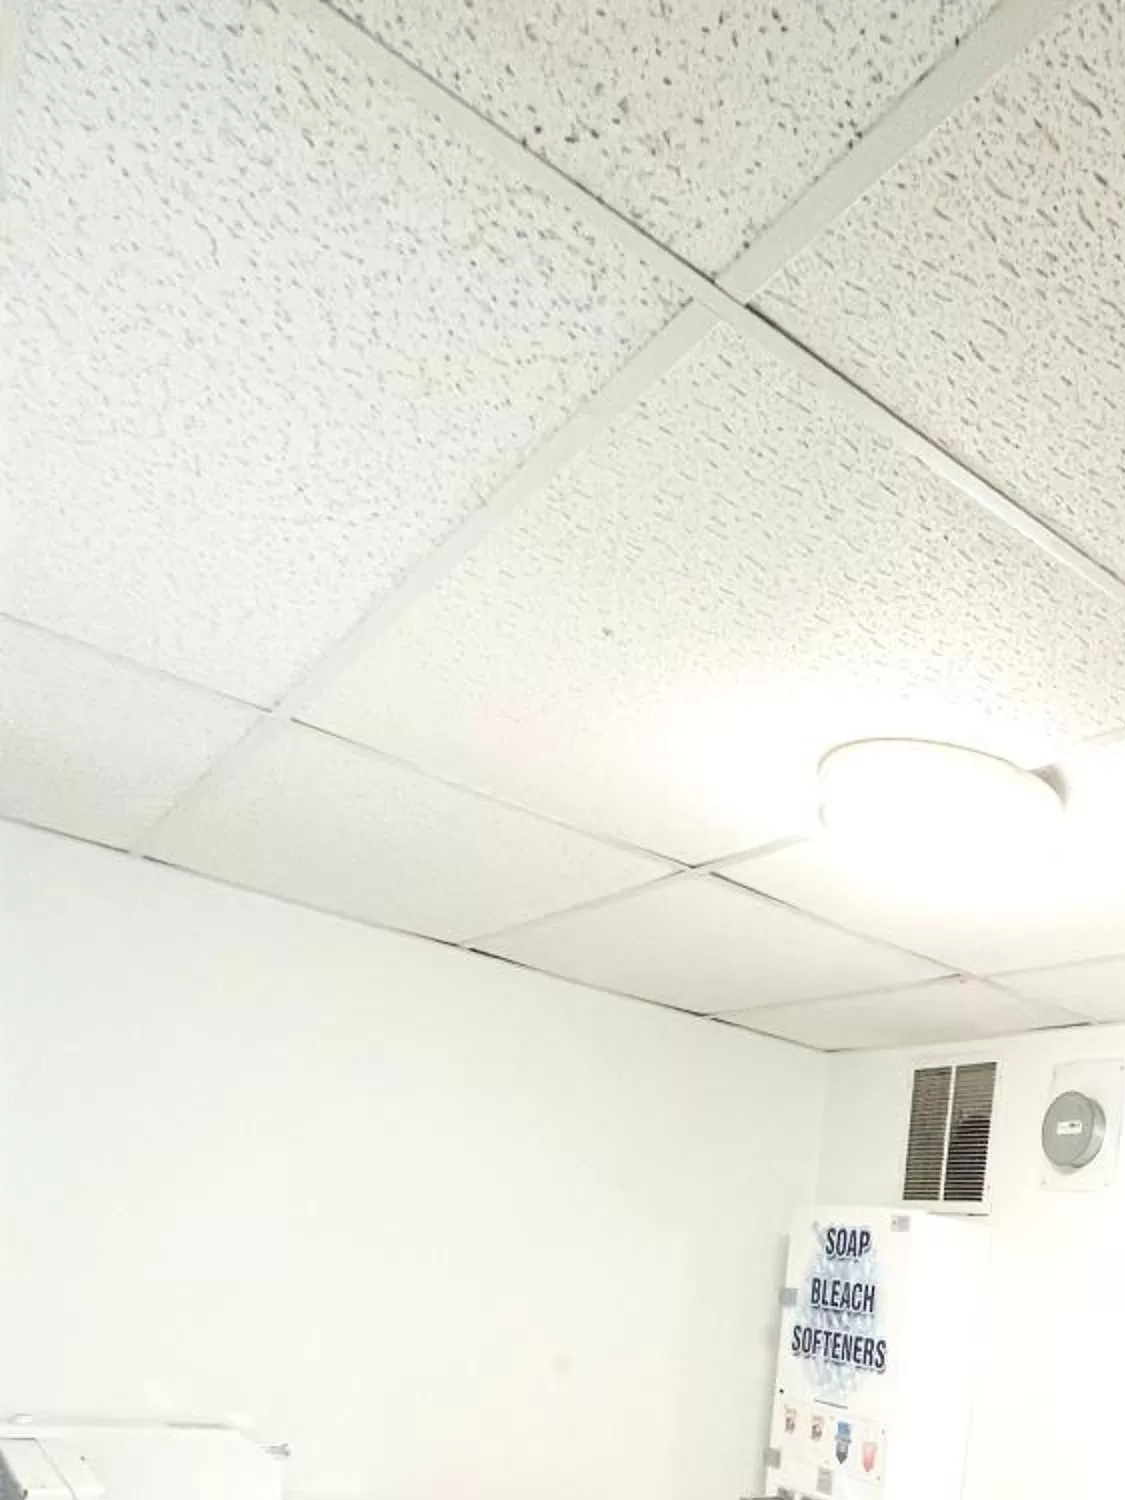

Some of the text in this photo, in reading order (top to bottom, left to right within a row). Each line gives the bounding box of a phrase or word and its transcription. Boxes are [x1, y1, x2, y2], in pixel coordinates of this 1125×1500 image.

[825, 1227, 871, 1257] SOAP
[811, 1276, 876, 1313] BLEACH
[791, 1324, 887, 1369] SOFTENERS
